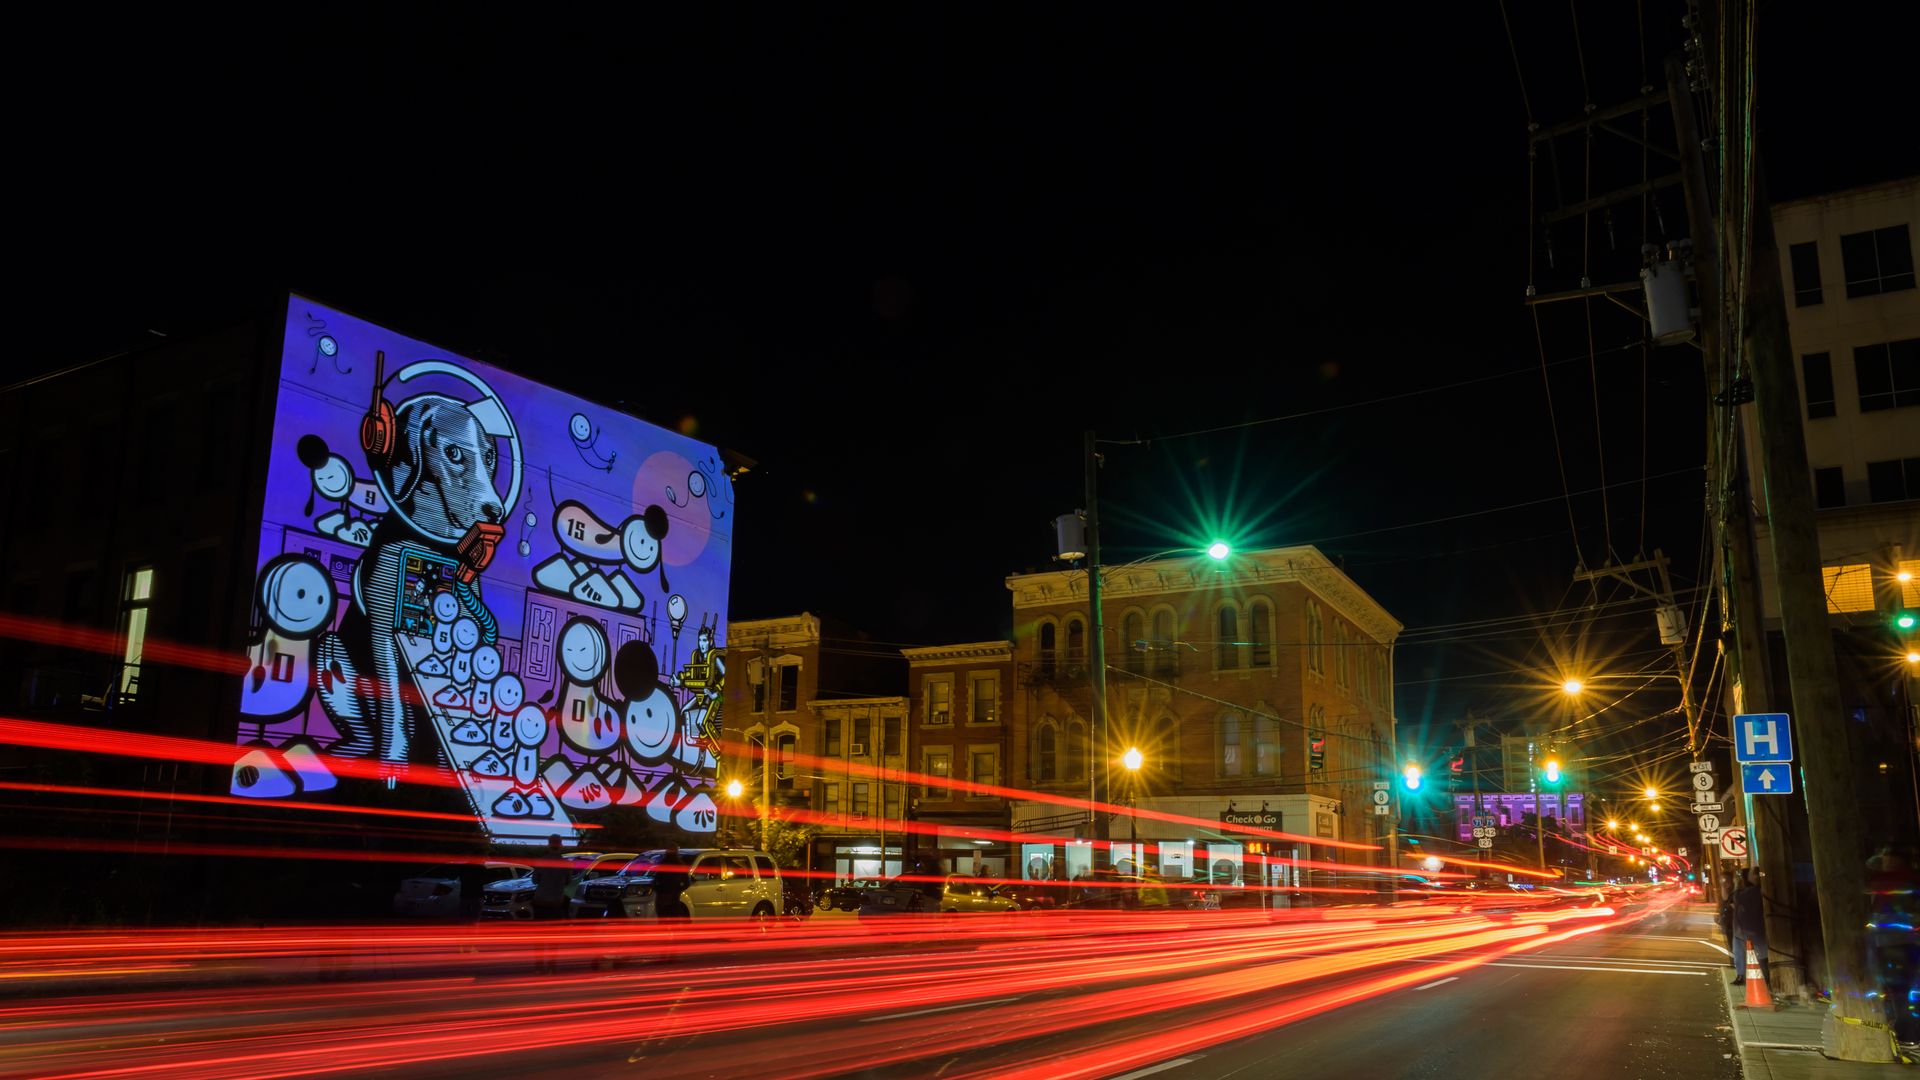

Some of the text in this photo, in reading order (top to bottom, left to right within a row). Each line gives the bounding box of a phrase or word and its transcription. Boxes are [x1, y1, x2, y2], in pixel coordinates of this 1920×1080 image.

[365, 490, 376, 505] 9
[567, 517, 586, 541] 15
[439, 631, 448, 643] 5
[458, 659, 467, 673] 4
[478, 691, 488, 704] 3
[499, 722, 511, 738] 2
[1744, 720, 1779, 755] H
[523, 755, 530, 771] 1
[1700, 776, 1708, 787] 8
[1379, 793, 1384, 801] 8
[1226, 815, 1255, 824] Check
[1263, 815, 1277, 824] Go
[1703, 818, 1715, 828] 17
